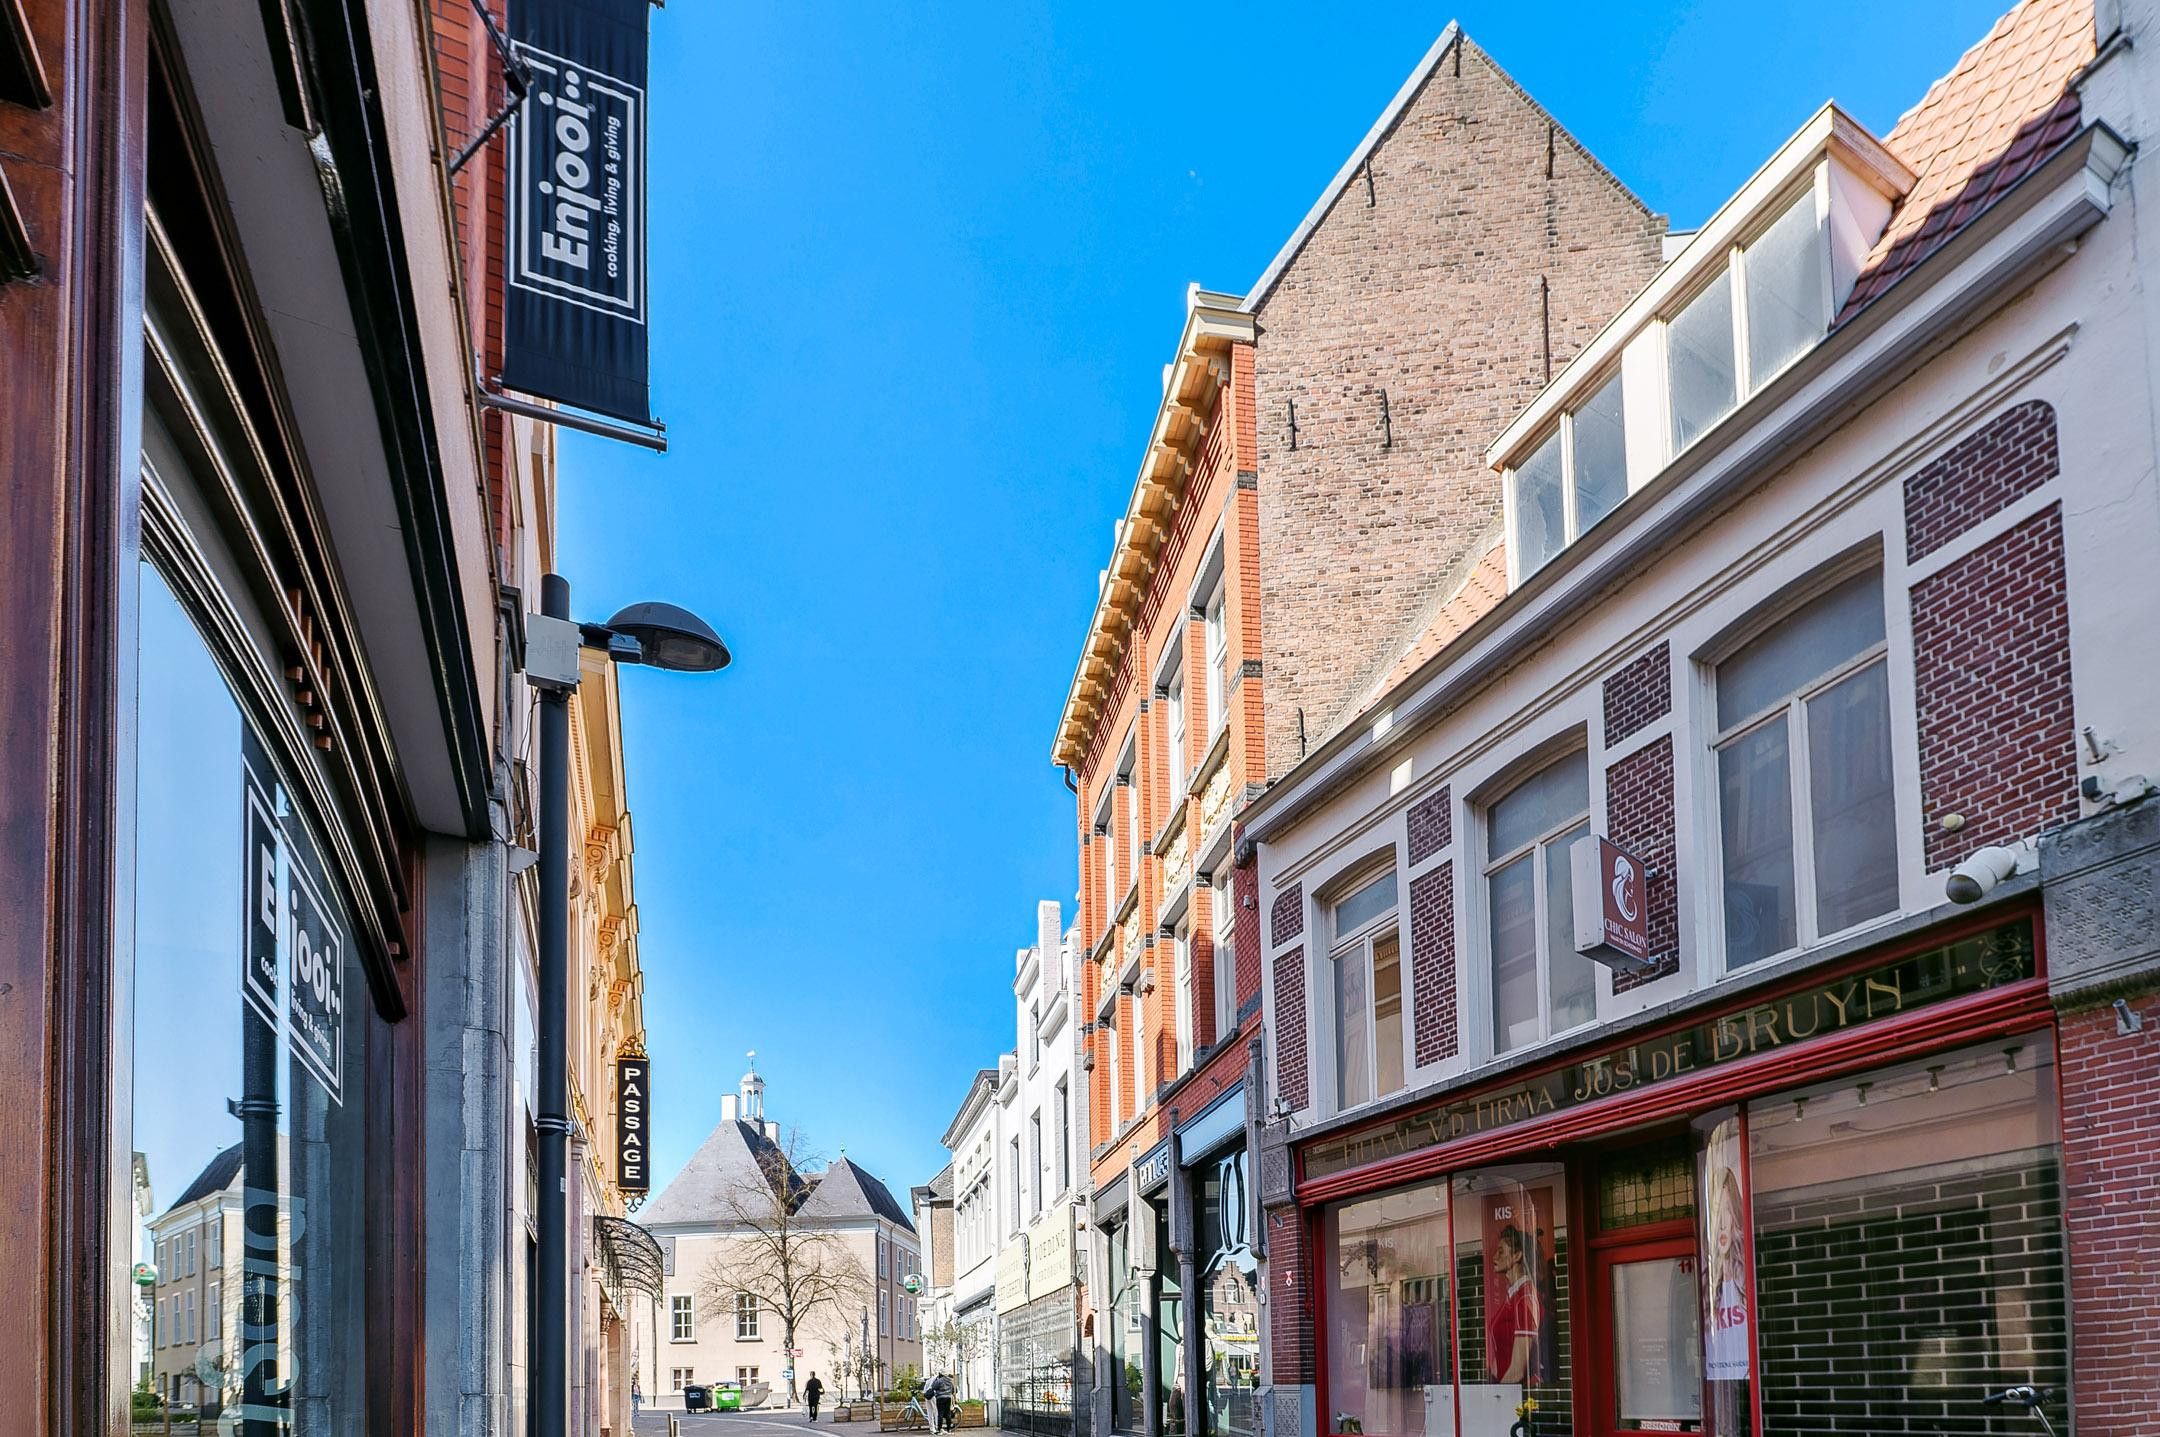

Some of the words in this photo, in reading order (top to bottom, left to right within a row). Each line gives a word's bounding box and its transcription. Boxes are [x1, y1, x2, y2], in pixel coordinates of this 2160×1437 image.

[604, 115, 621, 161] giving
[605, 163, 618, 175] &
[604, 177, 620, 216] living
[604, 220, 620, 278] cooking,
[1604, 918, 1623, 935] CHIC
[1624, 927, 1647, 948] SALON
[1476, 1087, 1555, 1130] FIRMA
[1651, 1041, 1696, 1081] DE
[1712, 969, 1902, 1062] BRUYN
[623, 1067, 642, 1179] PASSAGE
[1494, 1206, 1512, 1221] KIS
[1377, 1237, 1394, 1249] KIS
[1678, 1260, 1692, 1273] 11
[1716, 1306, 1745, 1331] KIS
